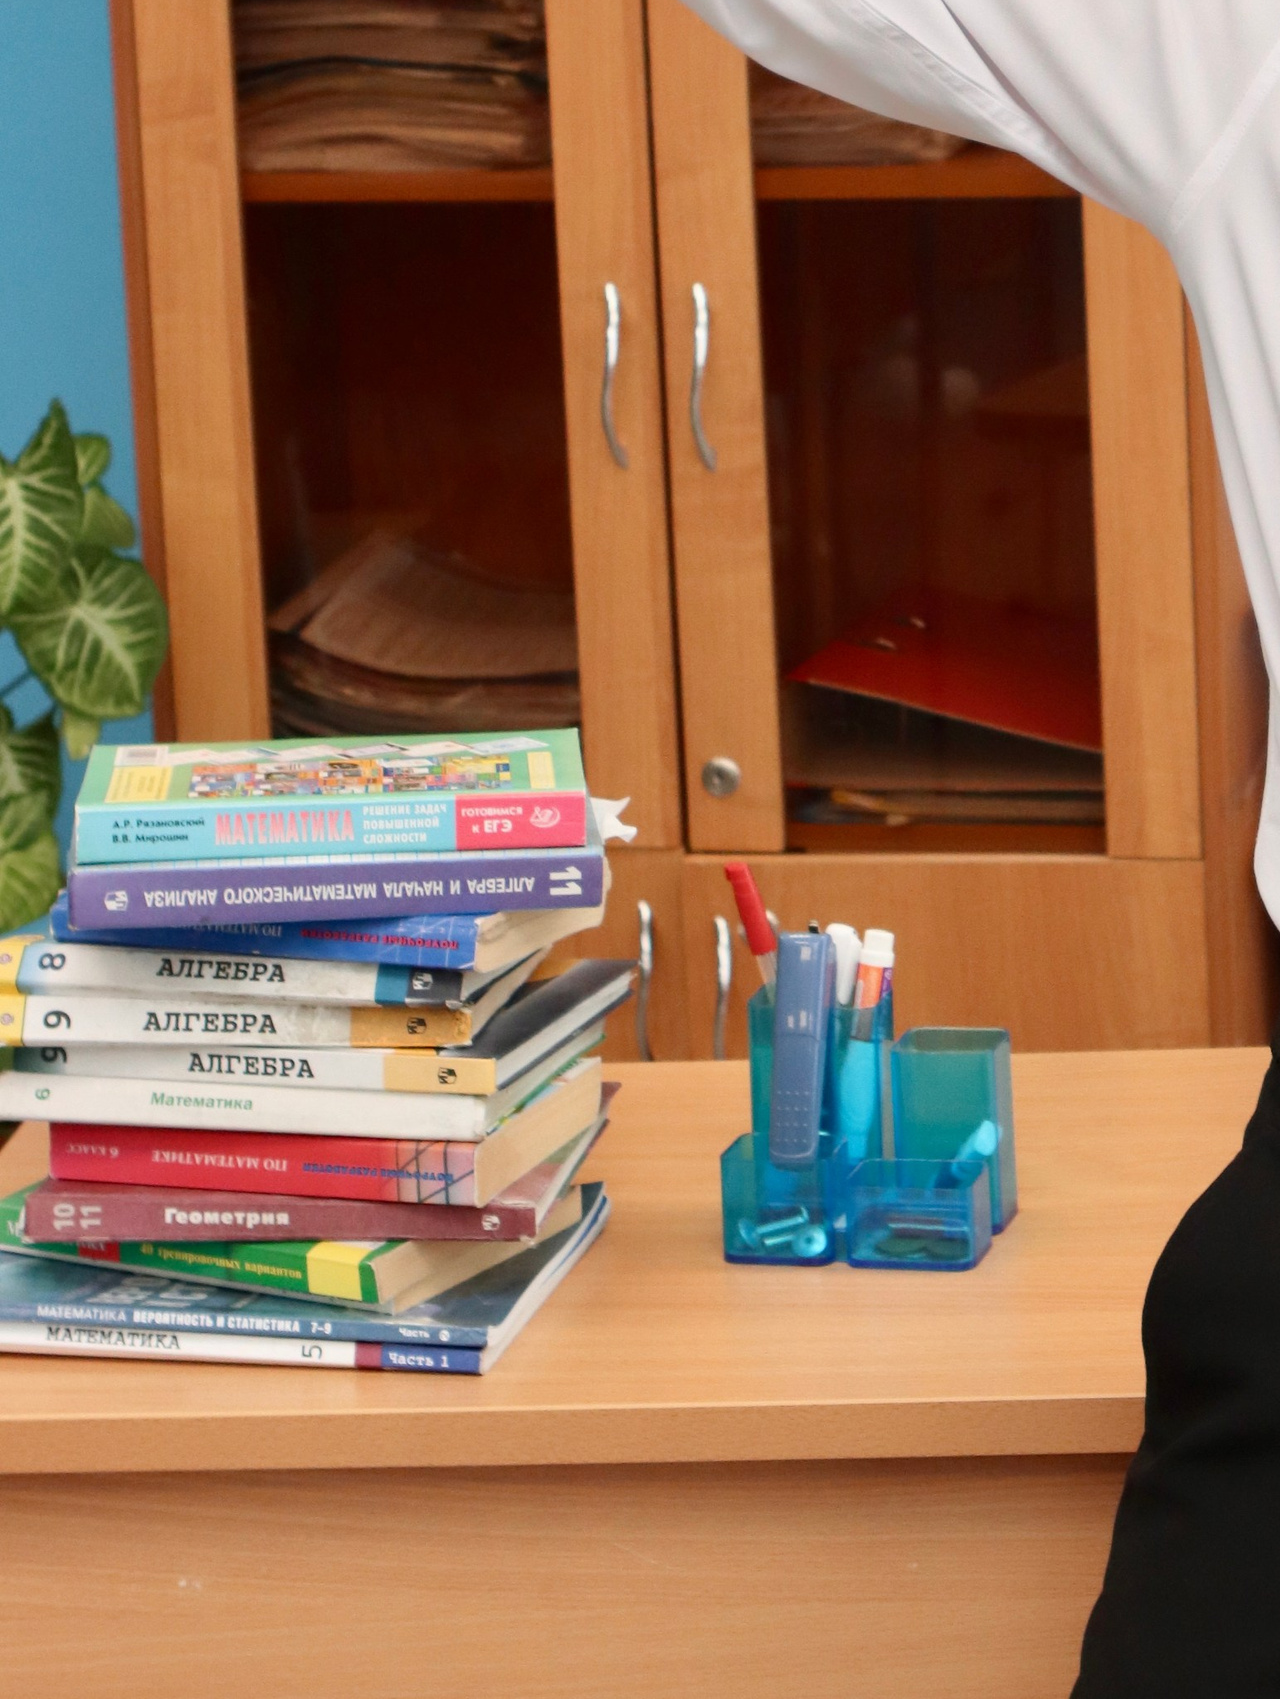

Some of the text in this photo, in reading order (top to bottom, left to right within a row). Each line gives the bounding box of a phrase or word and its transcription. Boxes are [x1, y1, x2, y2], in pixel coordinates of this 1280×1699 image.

[362, 803, 447, 817] РЕШЕНИЕ ЗАДАЧ
[461, 806, 523, 817] ГОТОВИМСЯ
[214, 808, 355, 846] МАТЕМАТИКА
[362, 816, 440, 831] ПОВЫШЕННОЙ
[484, 818, 513, 833] ЕГЭ
[362, 832, 427, 844] СЛОЖНОСТИ
[143, 876, 536, 908] АЛГЕБРА И НАЧАЛА МАТЕМАТИЧЕСКОГО АНАЛИЗА
[549, 865, 583, 896] 11
[383, 934, 459, 950] ПОУРОЧНЫЕ
[38, 952, 285, 983] 8 АЛГЕБРА
[43, 1010, 277, 1034] 9 АЛГЕБРА
[188, 1052, 315, 1079] АЛГЕБРА
[150, 1091, 253, 1111] Математика
[152, 1149, 259, 1170] МАТЕМАТИКЕ
[263, 1158, 287, 1172] ПО
[302, 1162, 378, 1177] РАЗРАБОТКИ
[53, 1203, 75, 1231] 10
[80, 1204, 102, 1230] 11
[164, 1207, 290, 1229] Геометрия
[157, 1248, 241, 1271] тренировочных
[245, 1260, 302, 1280] вариантов
[37, 1304, 127, 1323] МАТЕМАТИКА
[133, 1310, 214, 1328] ВЕРОЯТНОСТЬ
[216, 1315, 226, 1328] И
[227, 1315, 300, 1334] СТАТИСТИКА
[399, 1328, 430, 1339] Часть
[46, 1326, 449, 1368] МАТЕМАТИКА 5 Часть 1
